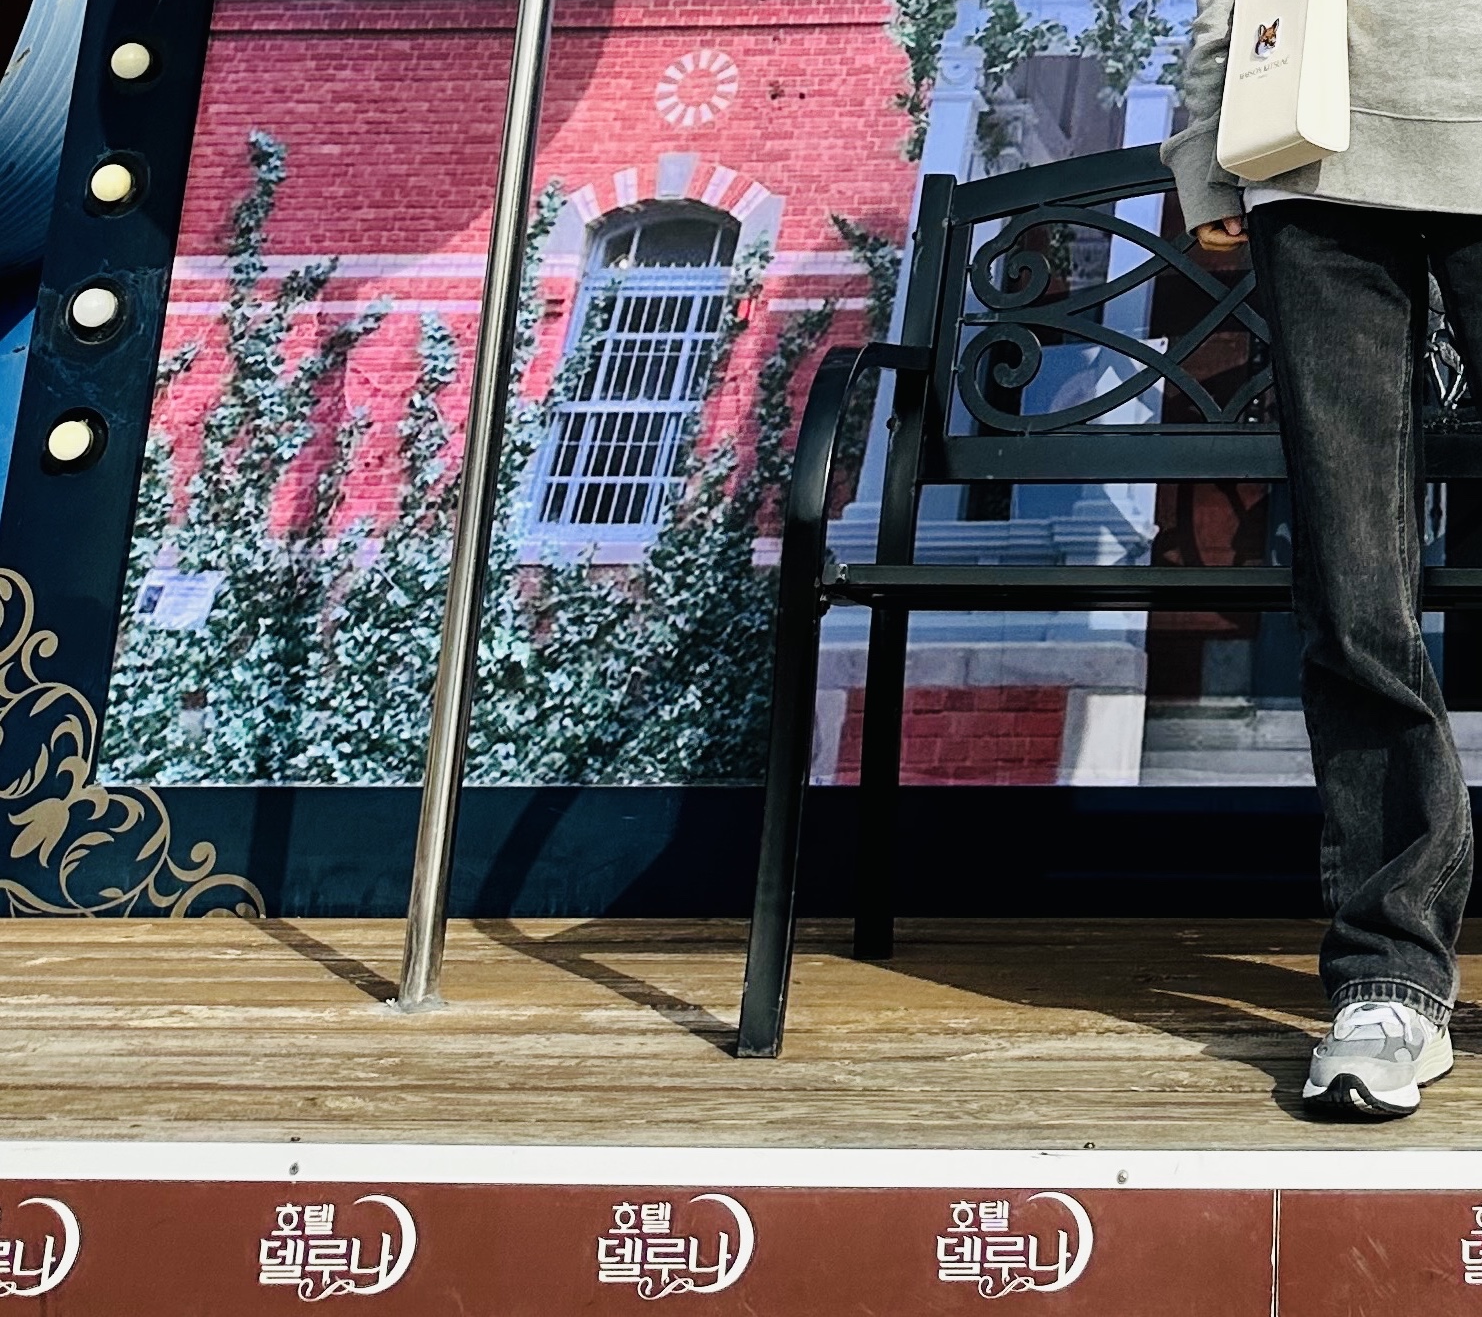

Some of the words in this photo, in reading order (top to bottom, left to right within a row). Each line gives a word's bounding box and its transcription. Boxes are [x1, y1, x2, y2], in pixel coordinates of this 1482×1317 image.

[272, 1203, 334, 1235] 호텔
[609, 1202, 671, 1234] 호텔
[947, 1200, 1009, 1232] 호텔
[0, 1232, 80, 1297] 나
[258, 1232, 416, 1301] 델루나
[597, 1231, 754, 1299] 델루나
[937, 1230, 1093, 1298] 델루나
